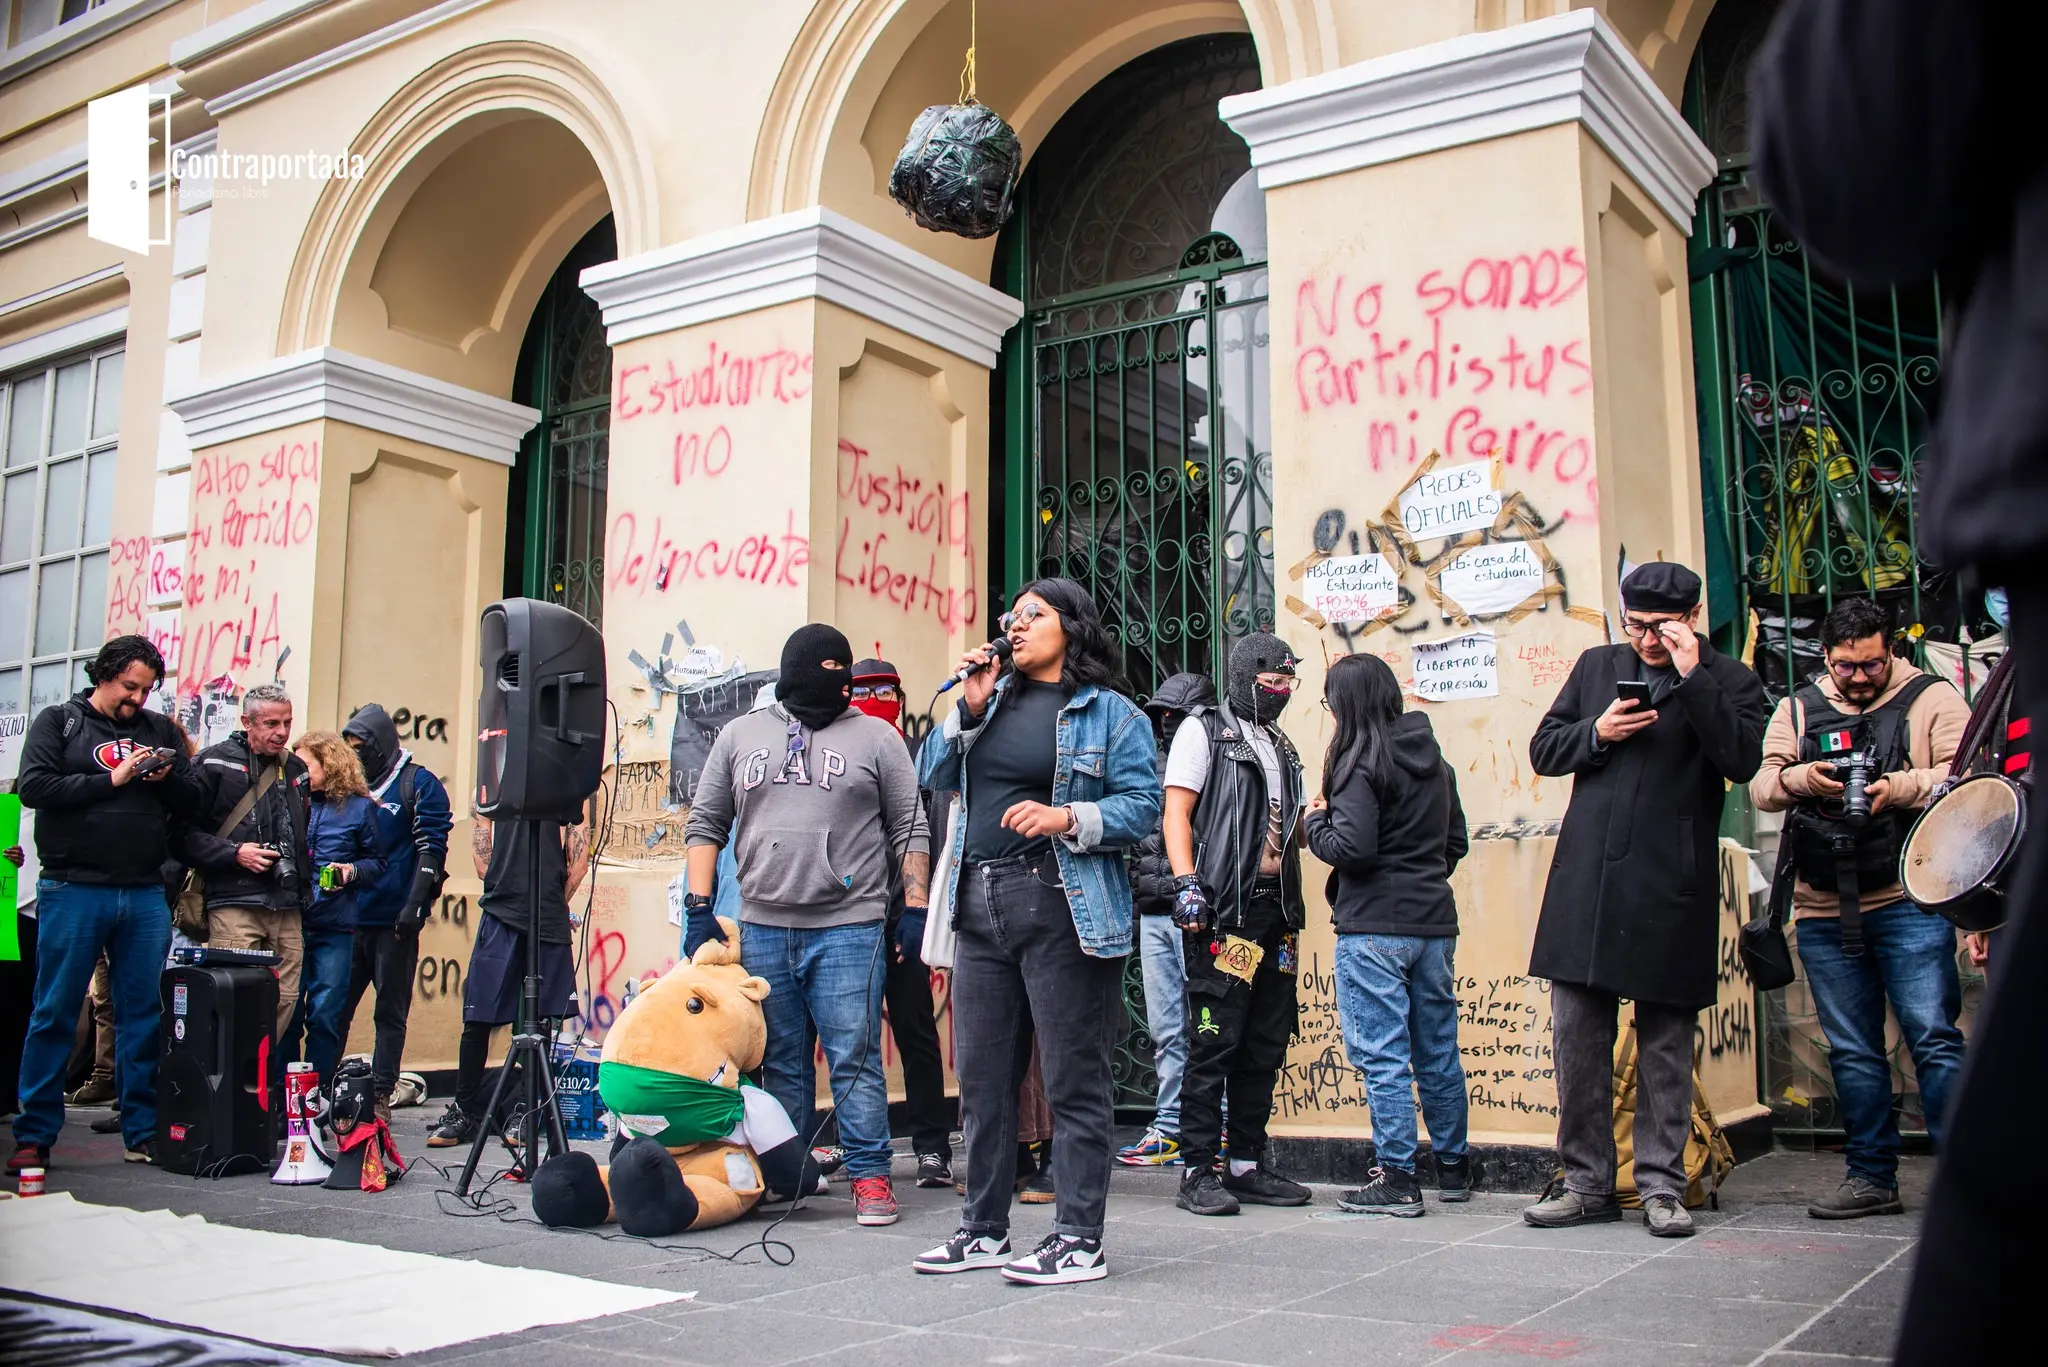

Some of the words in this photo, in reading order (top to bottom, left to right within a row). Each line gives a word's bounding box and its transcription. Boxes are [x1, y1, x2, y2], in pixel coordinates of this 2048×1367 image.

[1295, 273, 1384, 347] No
[1416, 246, 1588, 317] somos
[616, 339, 813, 420] Estudiantes
[672, 424, 733, 486] no
[195, 453, 251, 500] Alto
[837, 437, 972, 557] Justicia
[1415, 469, 1482, 497] REDES
[220, 497, 314, 549] Partido
[1405, 494, 1500, 533] OFICIALES
[1326, 576, 1394, 591] Estudiante
[1474, 563, 1540, 582] estudiante
[1416, 656, 1479, 672] LIBERTAD
[1483, 654, 1496, 667] DE
[1461, 637, 1476, 649] LA
[1517, 643, 1556, 661] LENIN
[743, 747, 846, 792] GAP
